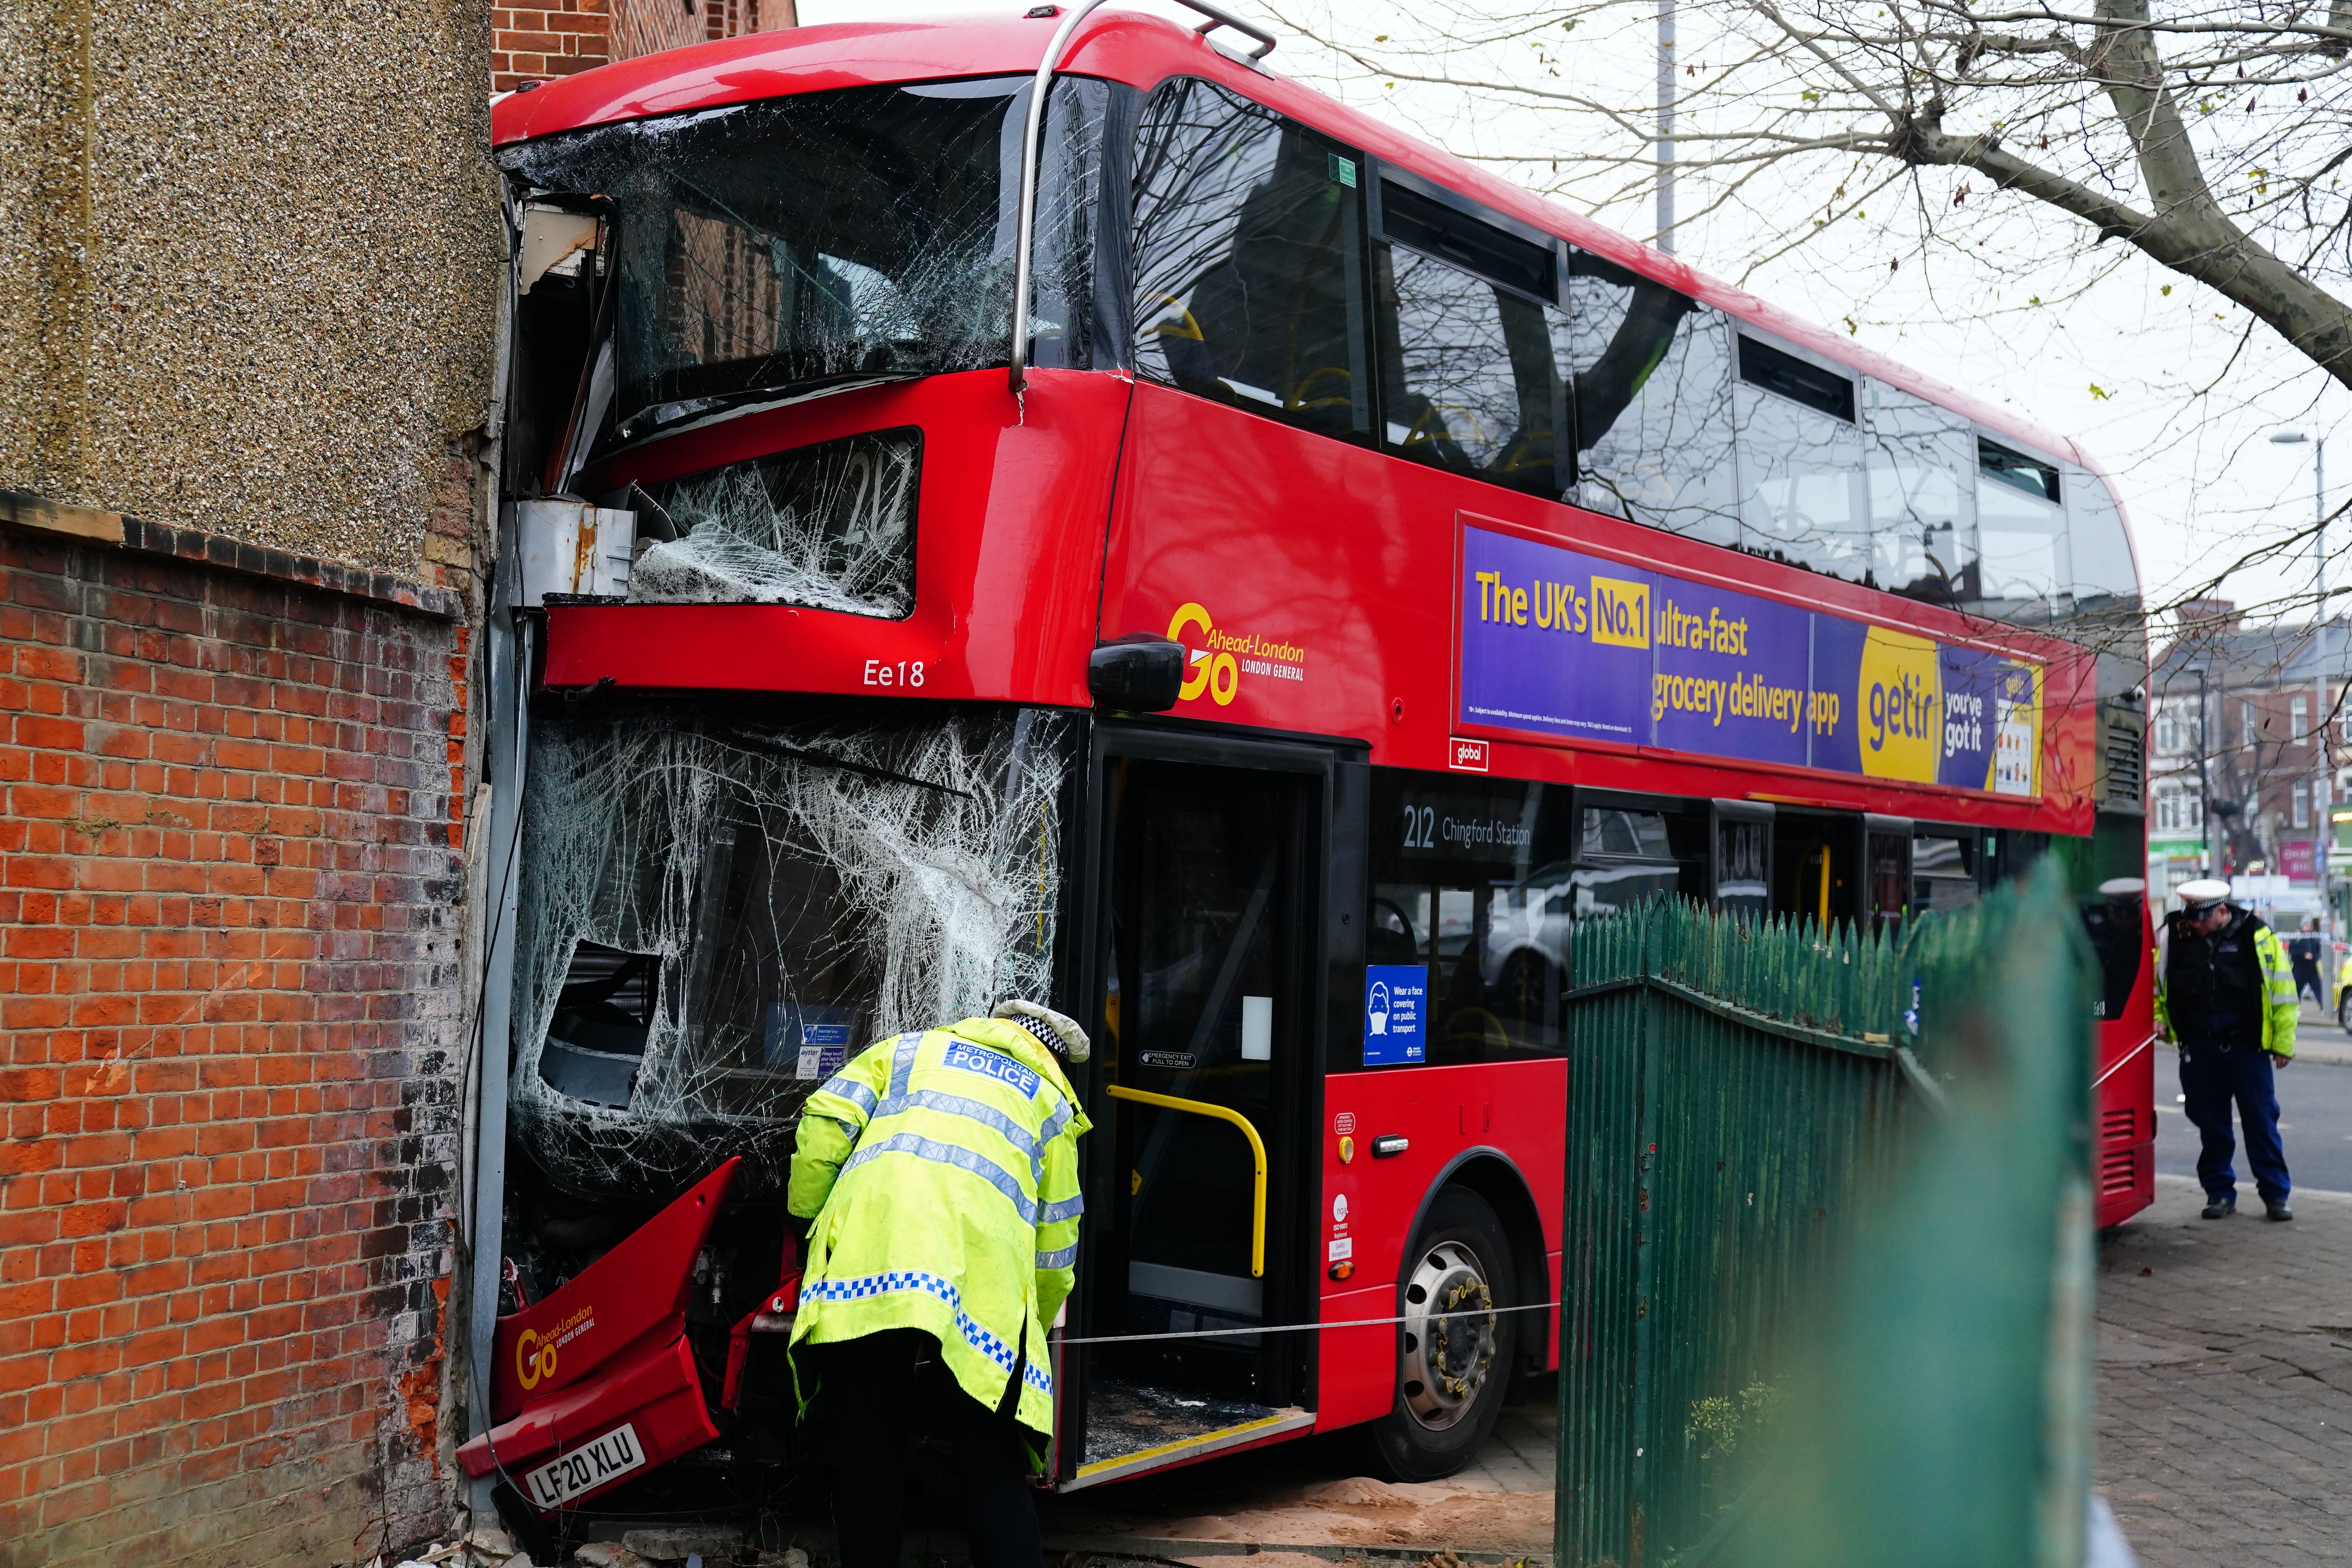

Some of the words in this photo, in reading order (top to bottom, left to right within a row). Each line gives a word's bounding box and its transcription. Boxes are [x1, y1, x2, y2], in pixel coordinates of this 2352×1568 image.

[1476, 571, 1528, 626] The
[1535, 580, 1587, 633] UK's
[1597, 588, 1644, 638] No.1
[1654, 599, 1748, 656] ultra-fast
[864, 660, 924, 687] Ee18
[1167, 603, 1238, 706] Go
[1206, 629, 1304, 663] Ahead-London
[1241, 659, 1271, 676] LONDON
[1273, 664, 1303, 681] GENERAL
[1651, 673, 1726, 727] grocery
[1730, 671, 1803, 734] delivery
[1806, 691, 1839, 736] app
[1870, 672, 1933, 752] getir
[1945, 691, 1982, 720] you've
[1457, 743, 1481, 764] global
[1945, 720, 1970, 758] got
[1971, 716, 1982, 752] it
[1403, 805, 1434, 848] 212
[1443, 817, 1493, 849] Chingford
[1496, 820, 1530, 846] Station
[1394, 986, 1407, 995] Wear
[1412, 986, 1423, 995] face
[1394, 999, 1415, 1010] covering
[2094, 1001, 2105, 1016] Ee18
[1393, 1024, 1416, 1034] transport
[1401, 1011, 1416, 1022] public
[952, 1051, 1034, 1093] POLICE
[957, 1044, 1035, 1079] METROPOLITAN
[536, 1305, 592, 1350] Ahead-London
[556, 1330, 574, 1348] LONDON
[575, 1317, 595, 1336] GENERAL
[516, 1328, 557, 1390] Go
[534, 1454, 591, 1503] LF20
[587, 1432, 633, 1477] XLU
